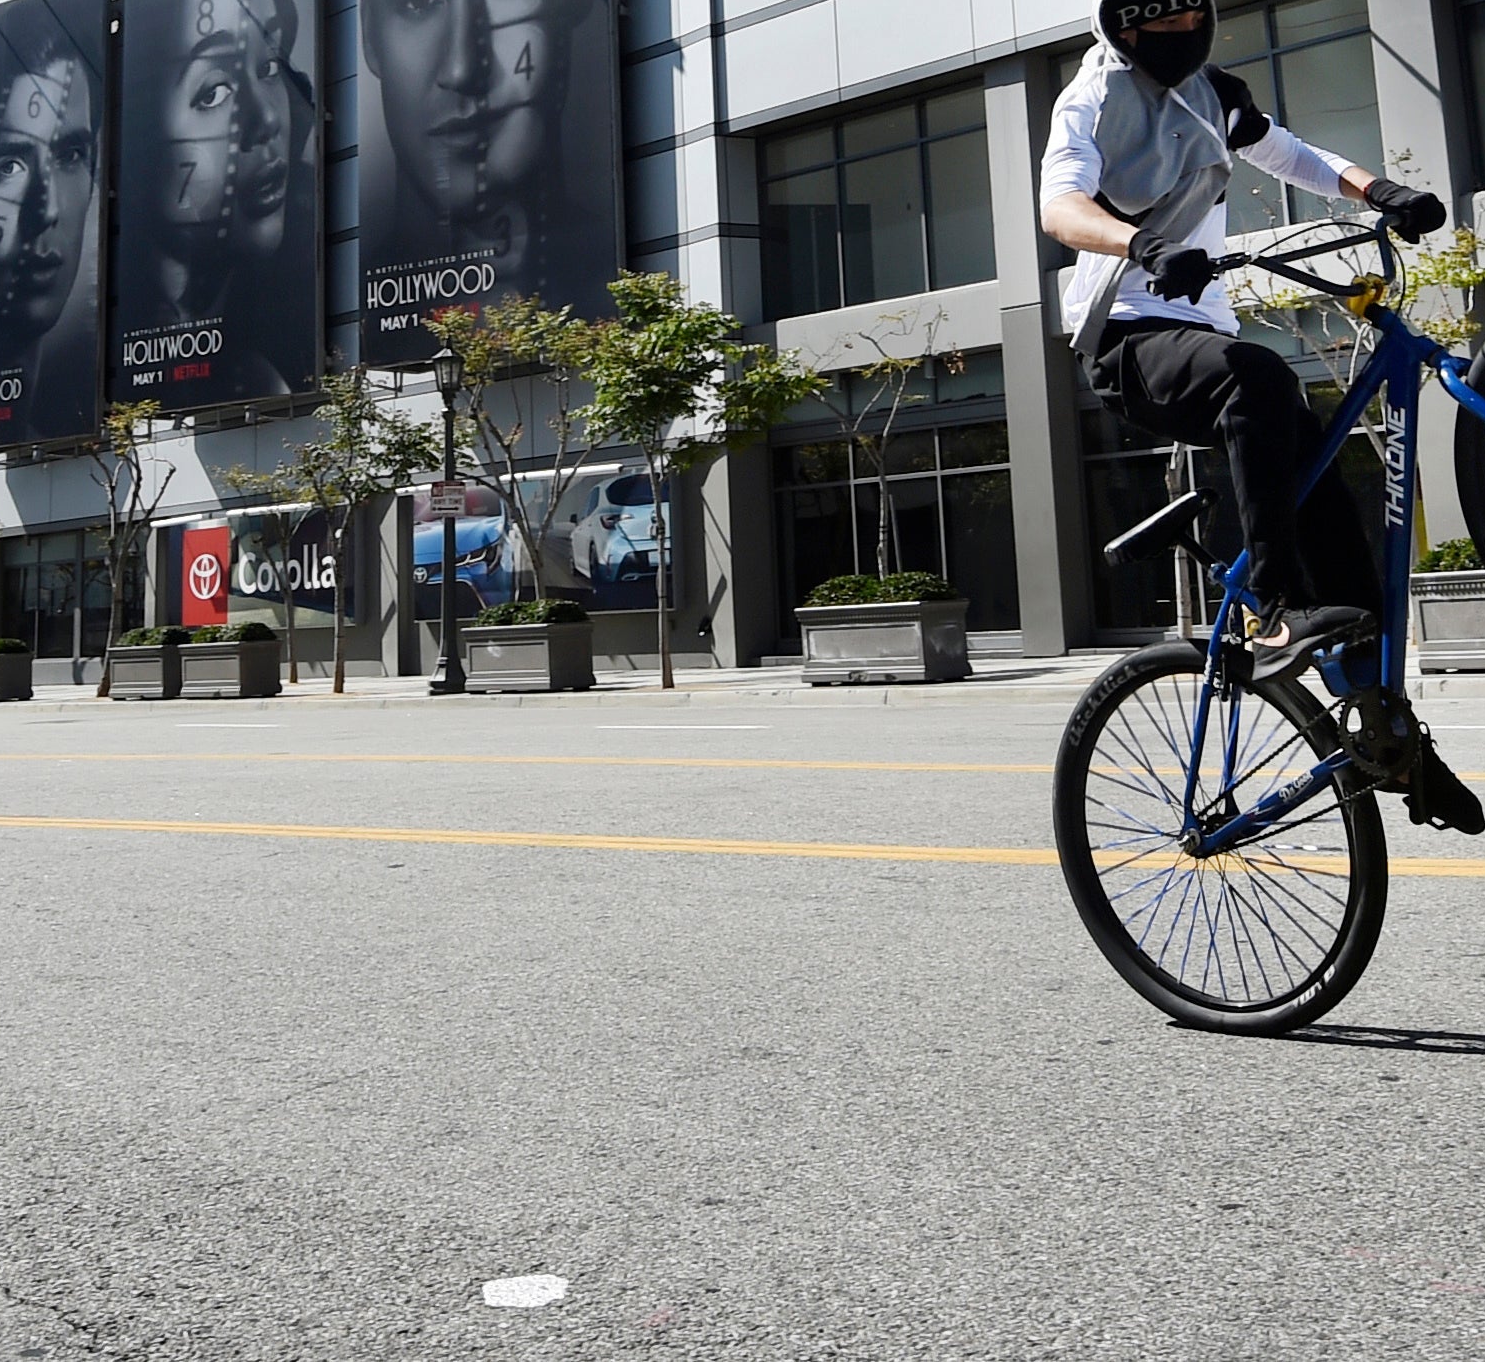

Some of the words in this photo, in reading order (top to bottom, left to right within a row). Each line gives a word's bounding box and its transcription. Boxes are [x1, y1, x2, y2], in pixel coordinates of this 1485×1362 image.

[514, 40, 535, 81] 4
[27, 91, 41, 119] 6
[178, 162, 197, 204] 7
[375, 263, 414, 274] NETFLIX
[417, 255, 456, 267] LIMITED
[461, 248, 495, 261] SERIES
[367, 263, 495, 309] HOLLYWOOD
[131, 327, 160, 337] NETFLIX
[163, 321, 193, 332] LIMITED
[196, 317, 223, 327] SERIES
[380, 314, 409, 332] MAY
[412, 313, 418, 327] 1
[123, 329, 223, 366] HOLLYWOOD
[132, 371, 156, 386] MAY
[157, 370, 163, 382] 1
[174, 362, 211, 381] NETFLIX
[1385, 403, 1406, 529] THRONE
[238, 543, 337, 594] Corolla
